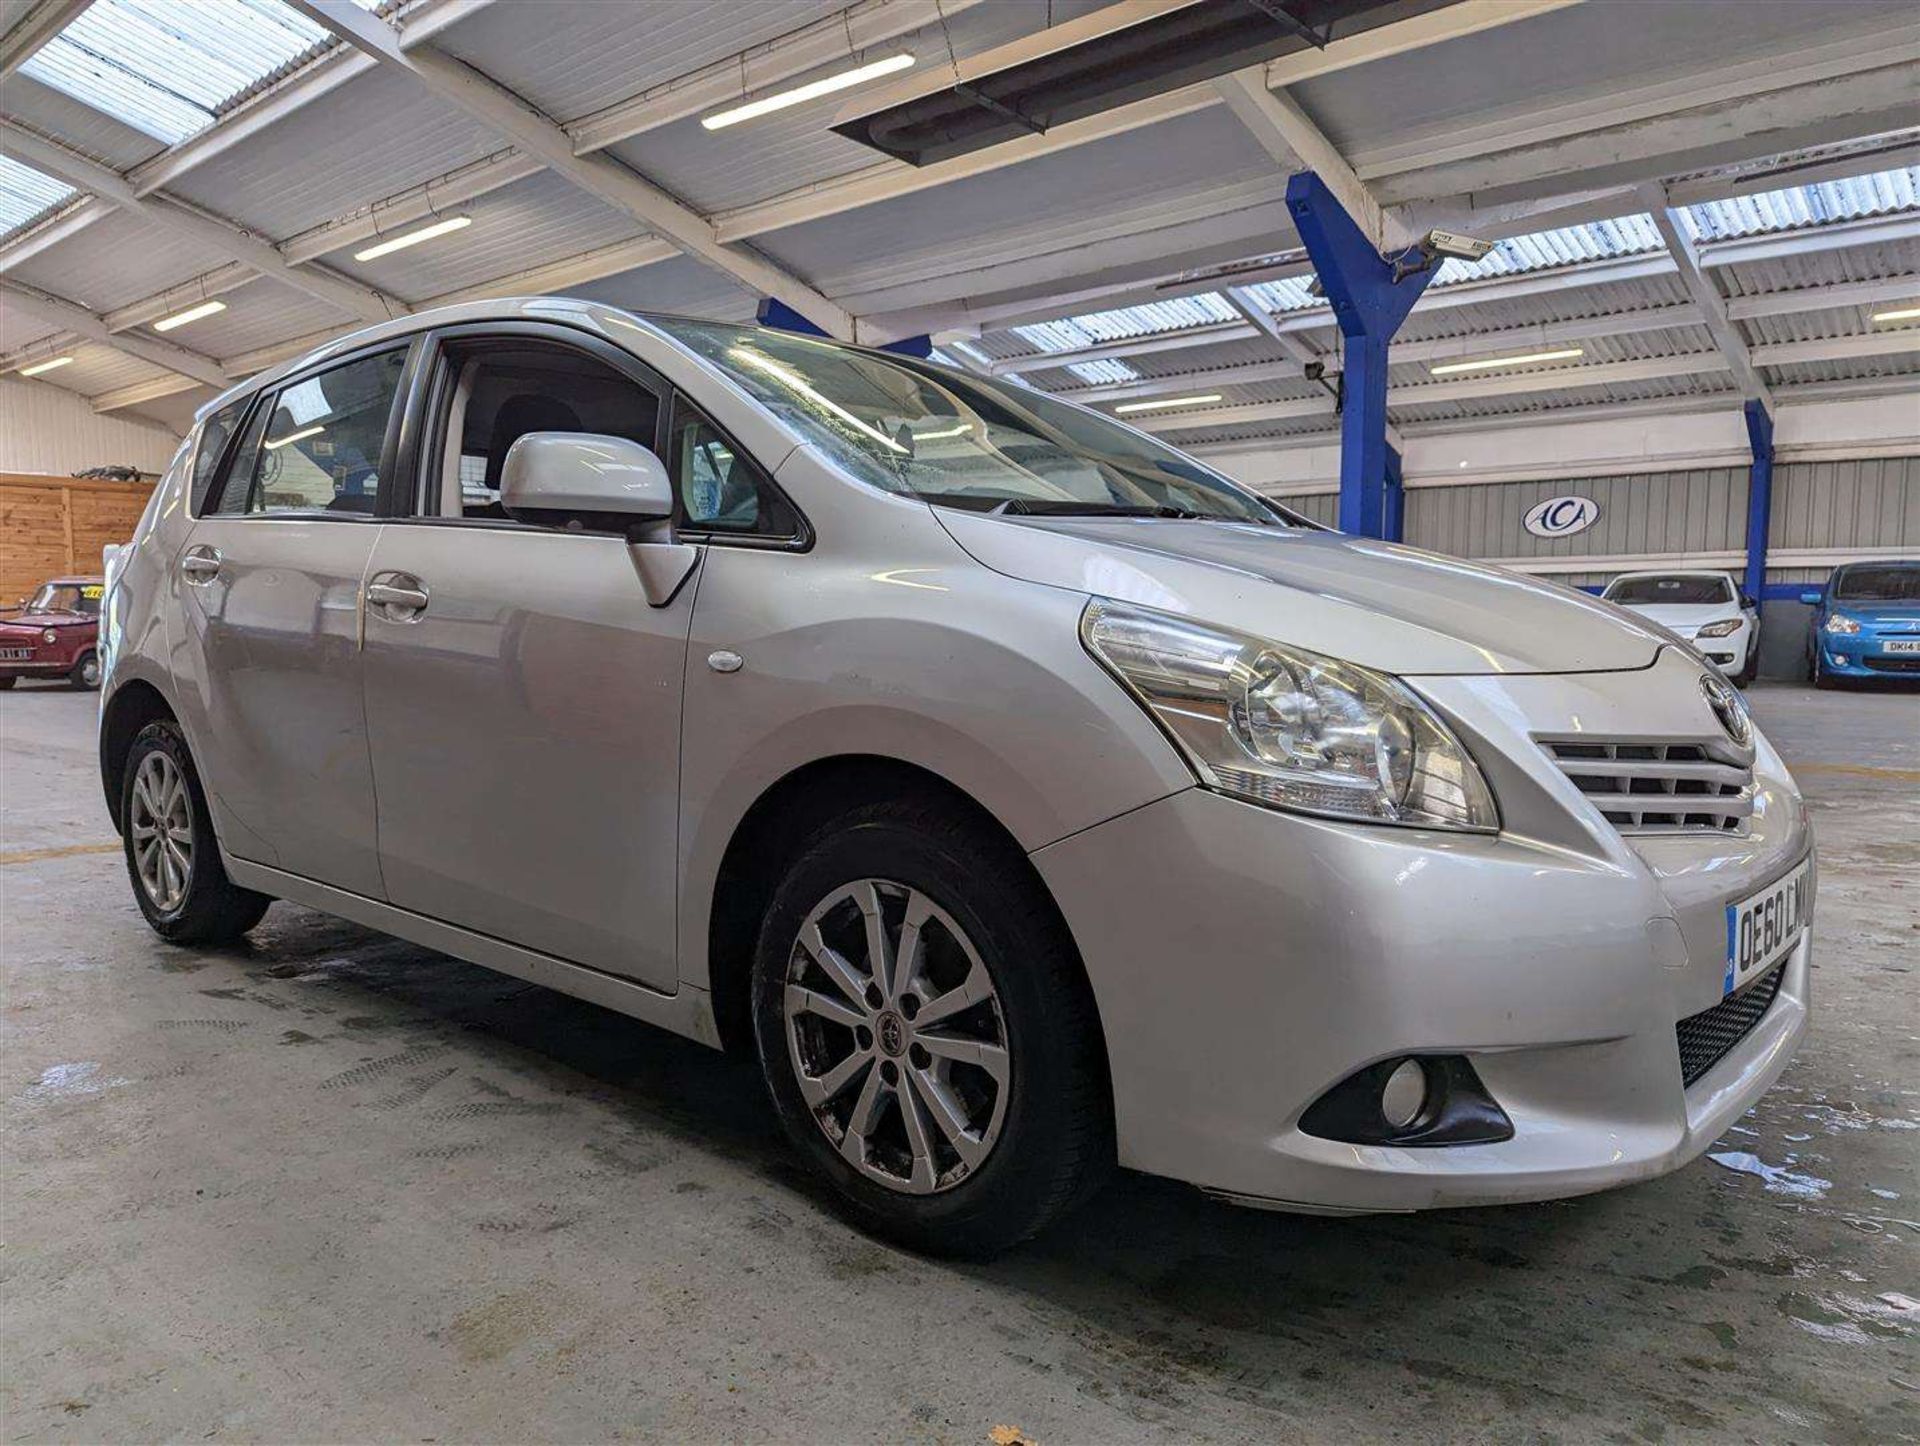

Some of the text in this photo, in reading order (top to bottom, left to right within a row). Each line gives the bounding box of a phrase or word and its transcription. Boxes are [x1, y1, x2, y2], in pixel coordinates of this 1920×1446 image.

[1528, 500, 1587, 531] ACA
[1890, 642, 1914, 652] DK14
[1740, 890, 1783, 972] OE60
